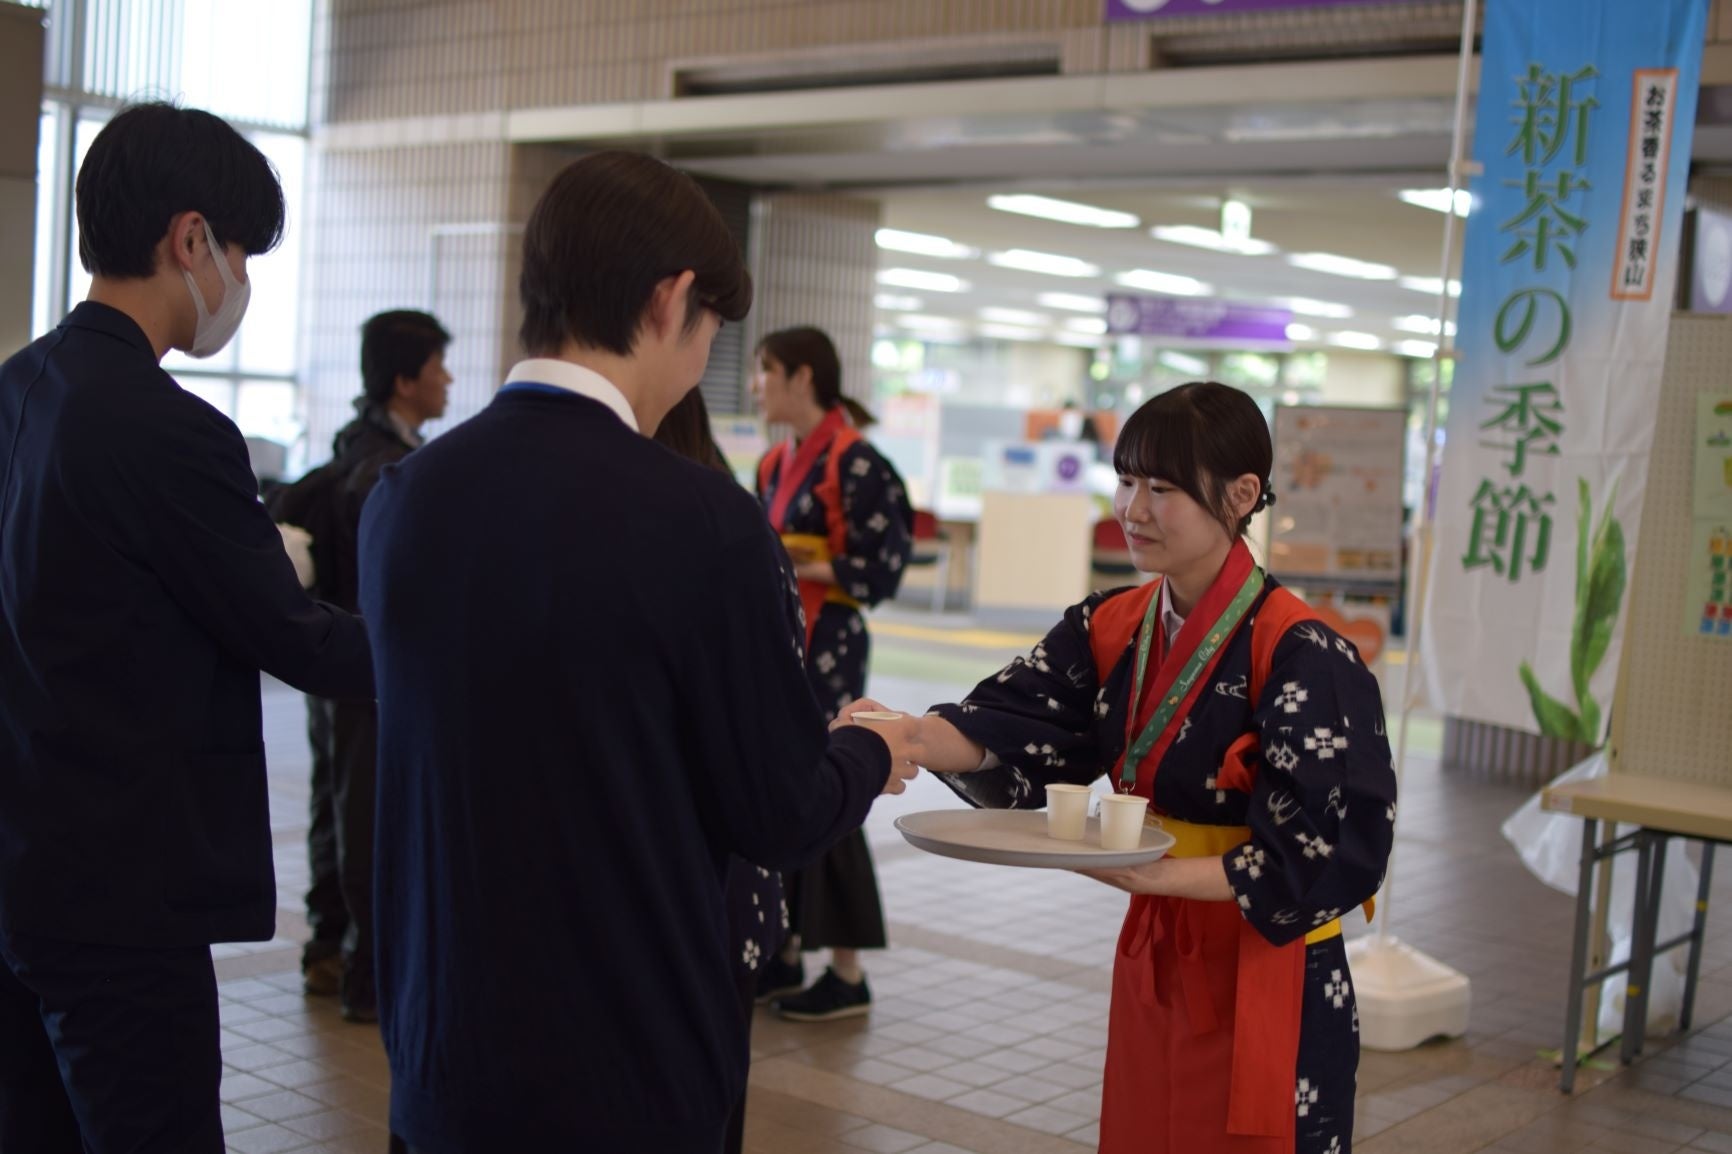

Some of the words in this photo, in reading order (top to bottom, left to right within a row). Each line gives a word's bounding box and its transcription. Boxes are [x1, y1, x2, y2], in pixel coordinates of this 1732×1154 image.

[1461, 63, 1600, 583] 新茶の季節
